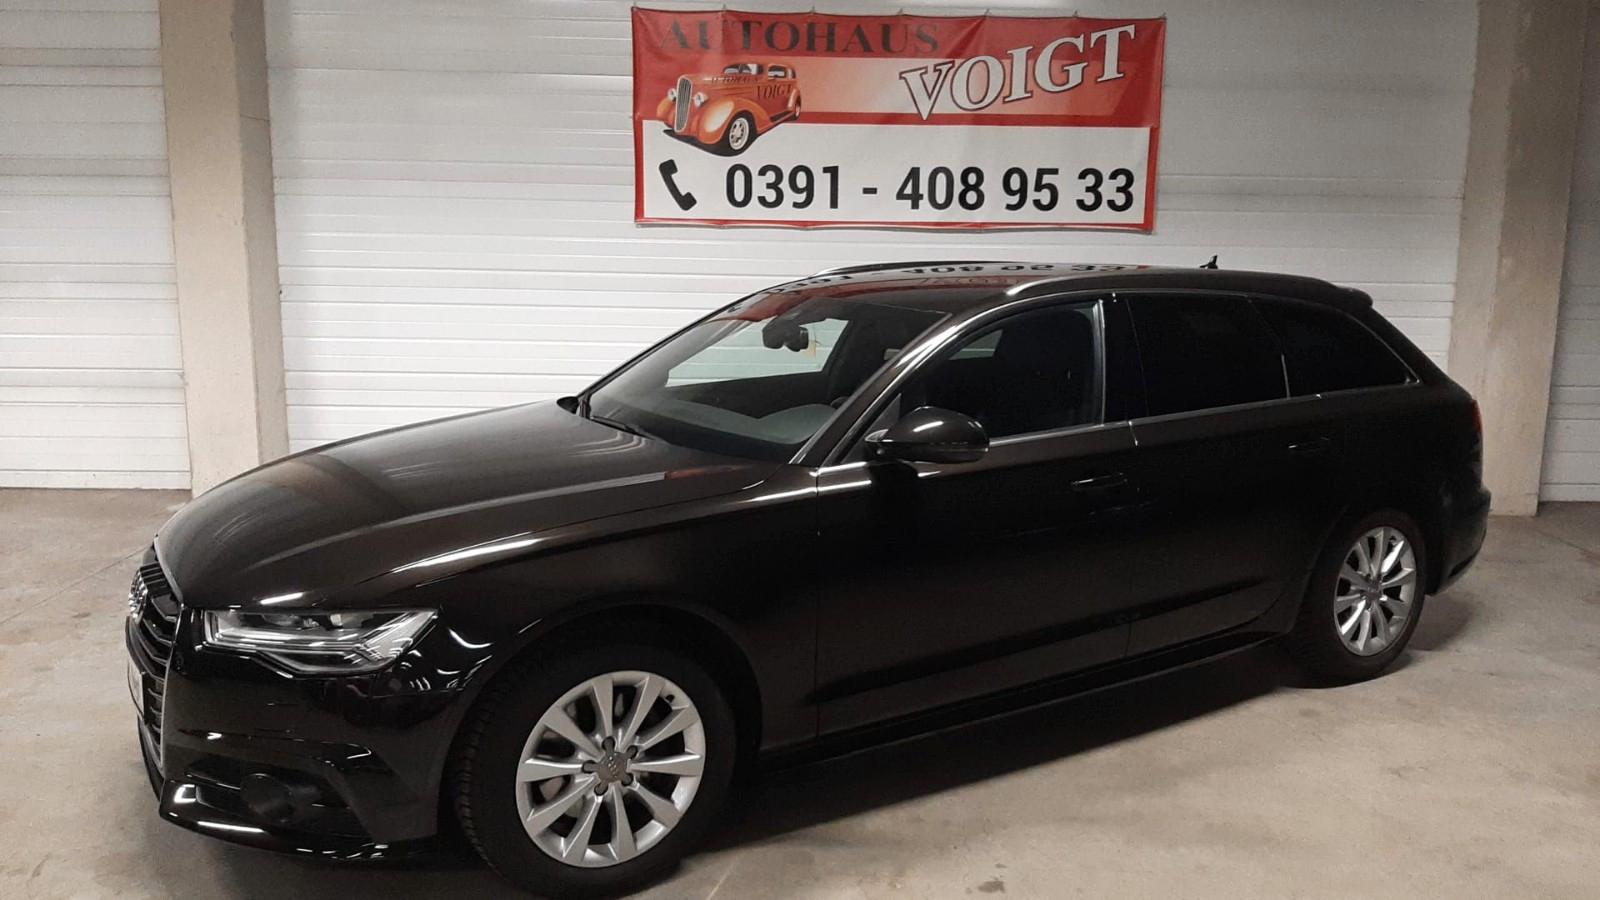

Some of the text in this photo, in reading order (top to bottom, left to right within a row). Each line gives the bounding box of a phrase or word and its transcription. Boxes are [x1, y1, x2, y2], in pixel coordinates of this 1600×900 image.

[660, 19, 940, 52] AUTOHAUS
[899, 24, 1137, 121] VOIGT
[726, 163, 1135, 212] 0391 - 408 95 33
